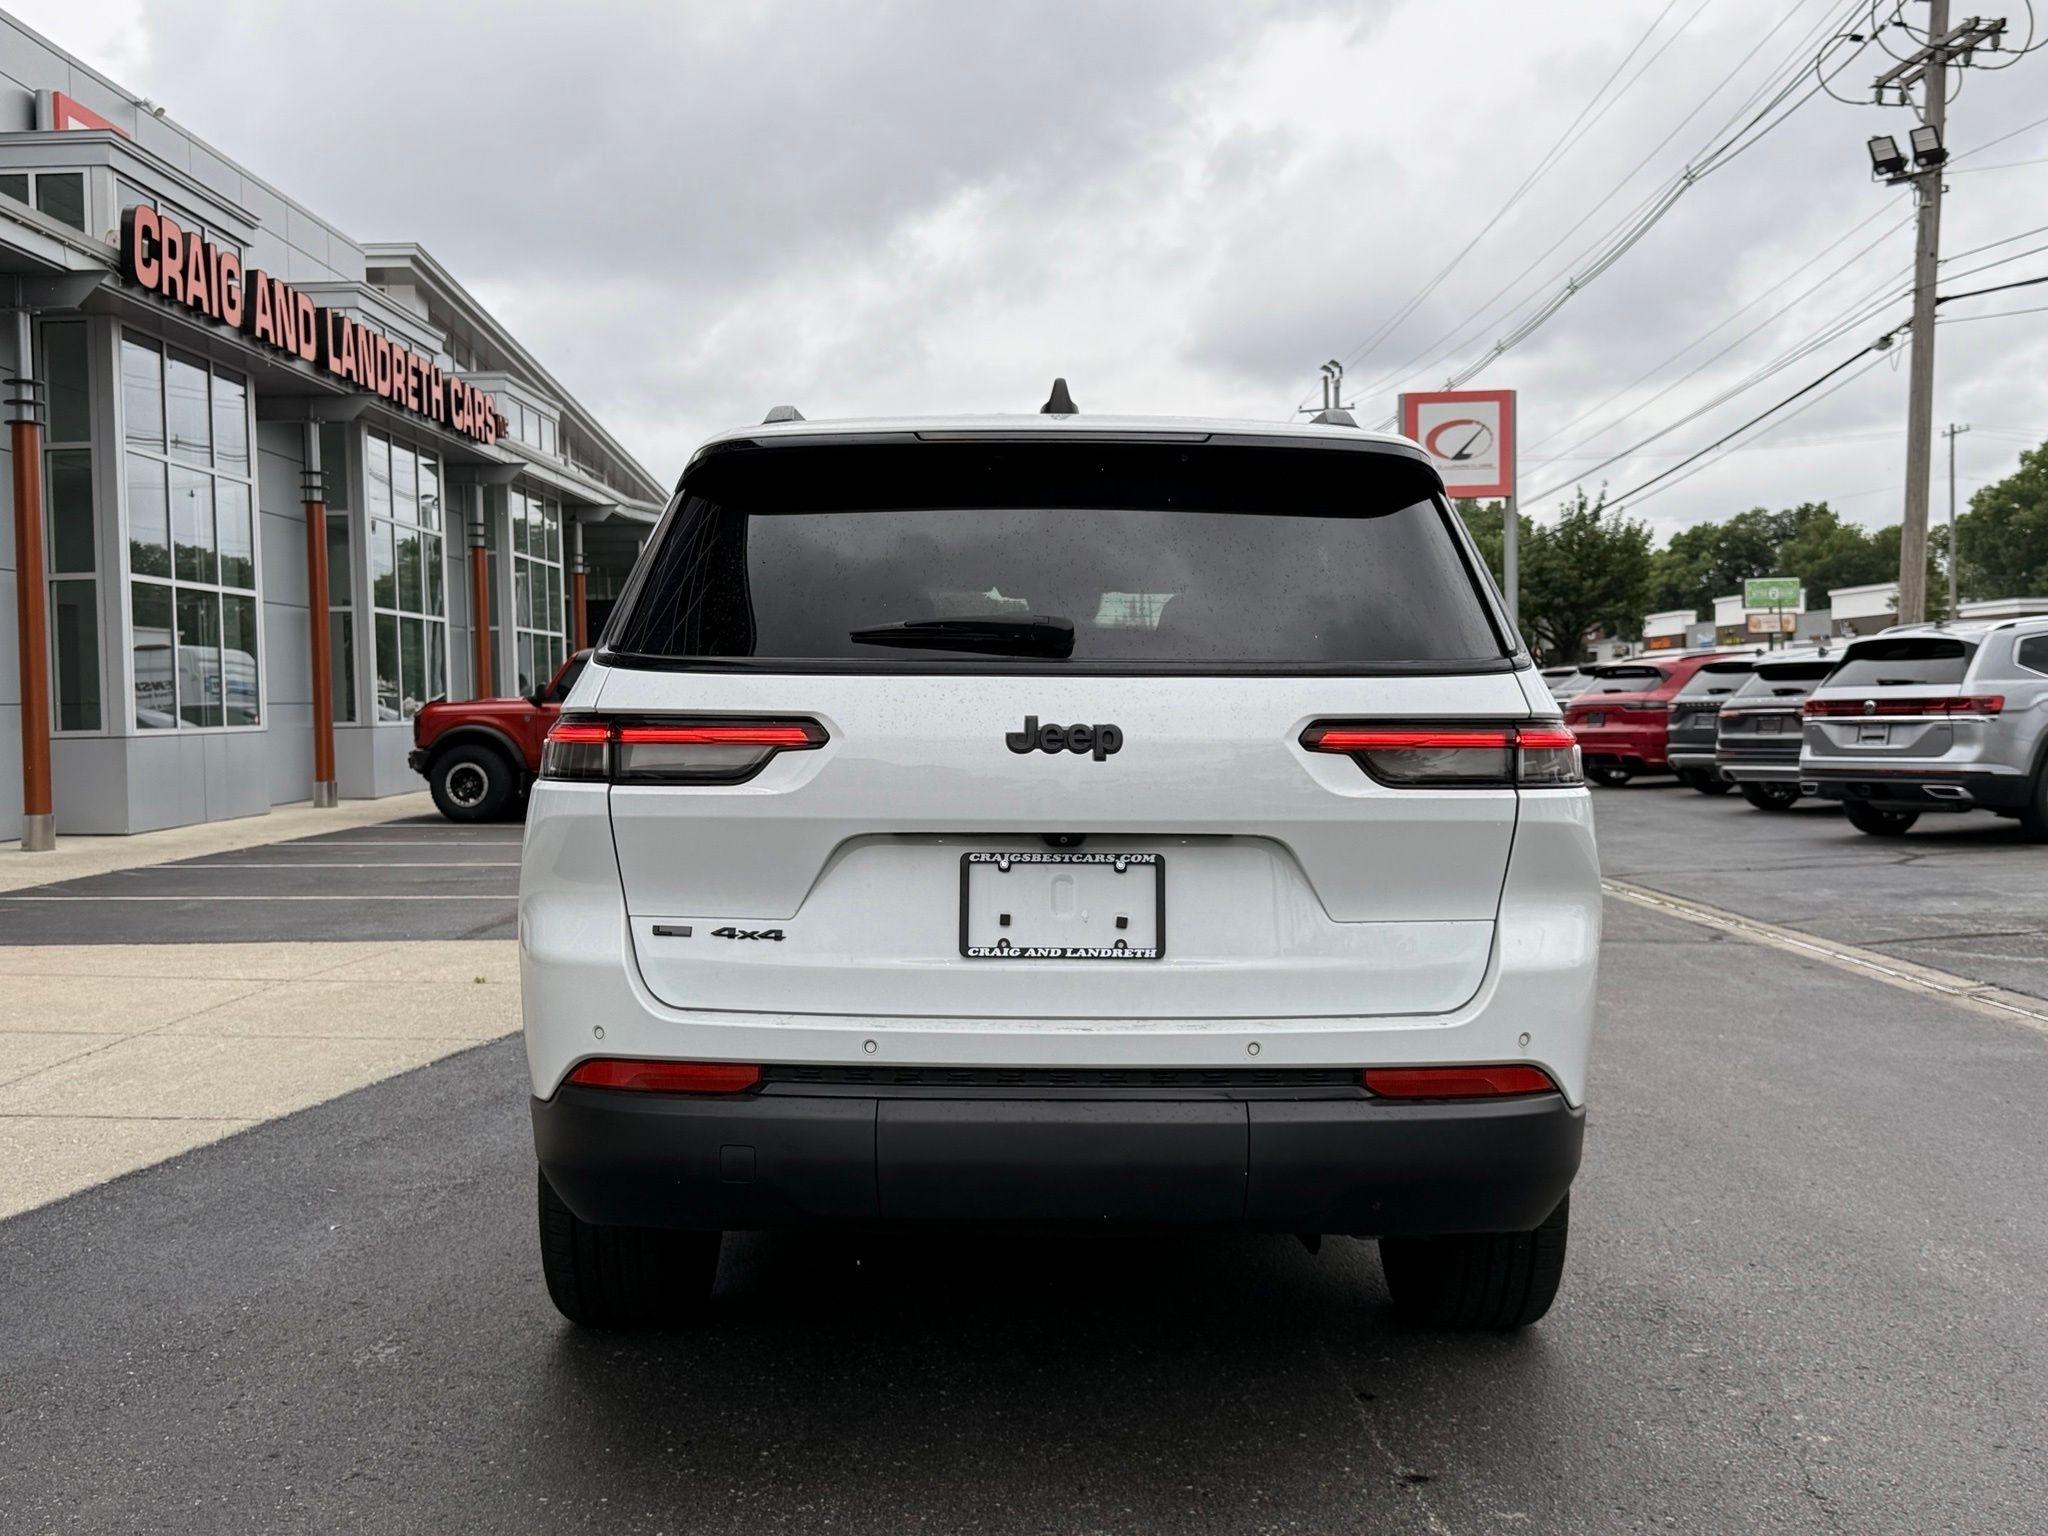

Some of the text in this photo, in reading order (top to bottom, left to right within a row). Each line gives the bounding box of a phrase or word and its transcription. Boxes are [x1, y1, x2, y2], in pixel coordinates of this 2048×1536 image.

[134, 204, 243, 328] CRAIG
[255, 270, 317, 362] AND
[326, 307, 445, 423] LANDRETH
[450, 376, 496, 446] CARS
[1005, 715, 1123, 761] Jeep
[969, 853, 1156, 863] CRAIGSBESTCARS.COM
[710, 927, 787, 941] 4x4
[968, 948, 1157, 958] CRAIG AND LANDRETH
